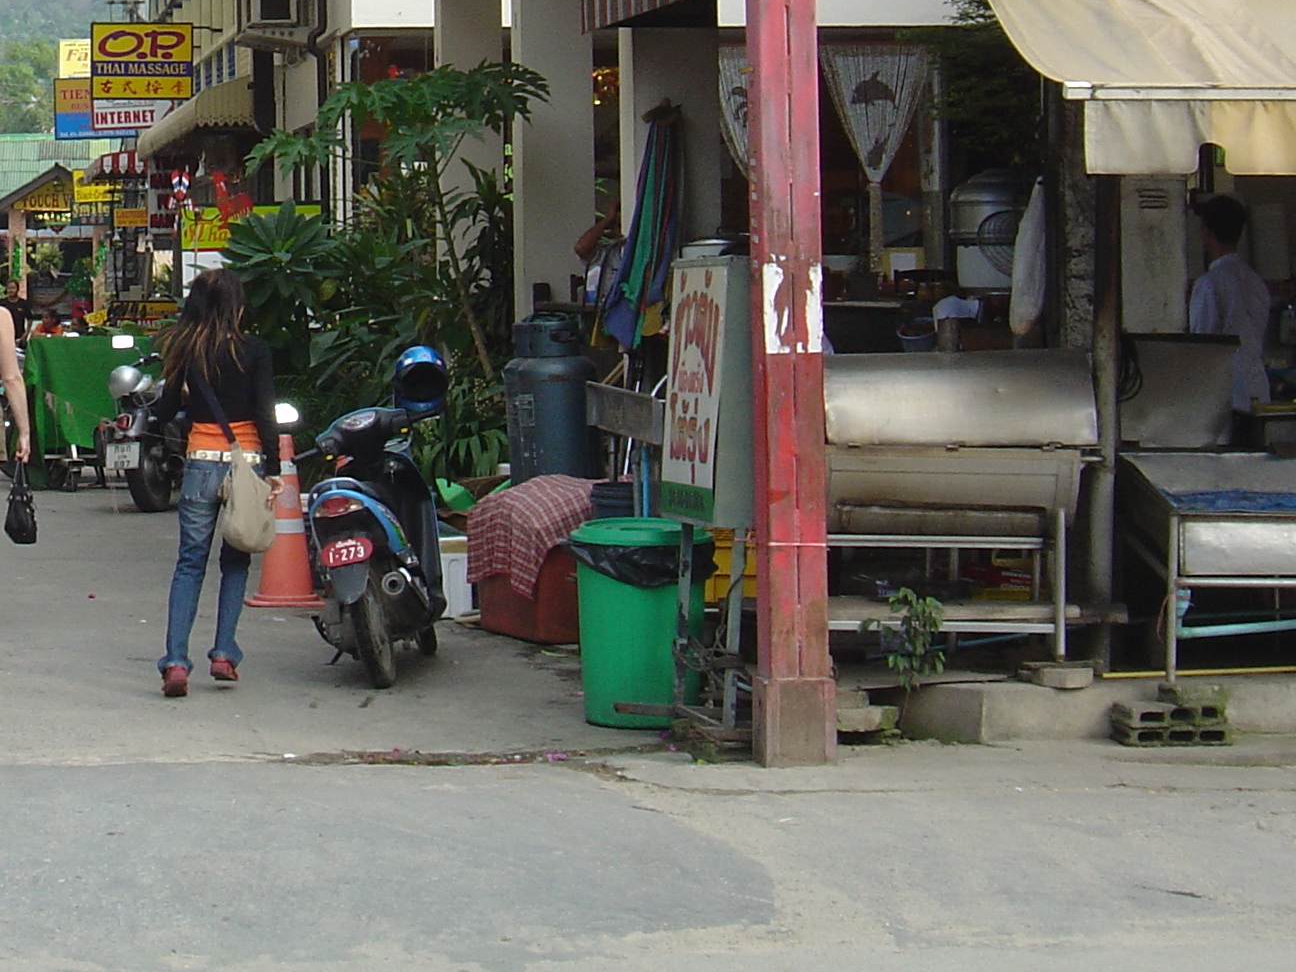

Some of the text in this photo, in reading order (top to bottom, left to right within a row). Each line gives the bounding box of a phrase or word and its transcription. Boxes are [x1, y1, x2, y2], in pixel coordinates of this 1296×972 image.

[95, 63, 125, 75] THAI
[127, 62, 188, 75] MASSAGE
[95, 109, 156, 125] INTERNET
